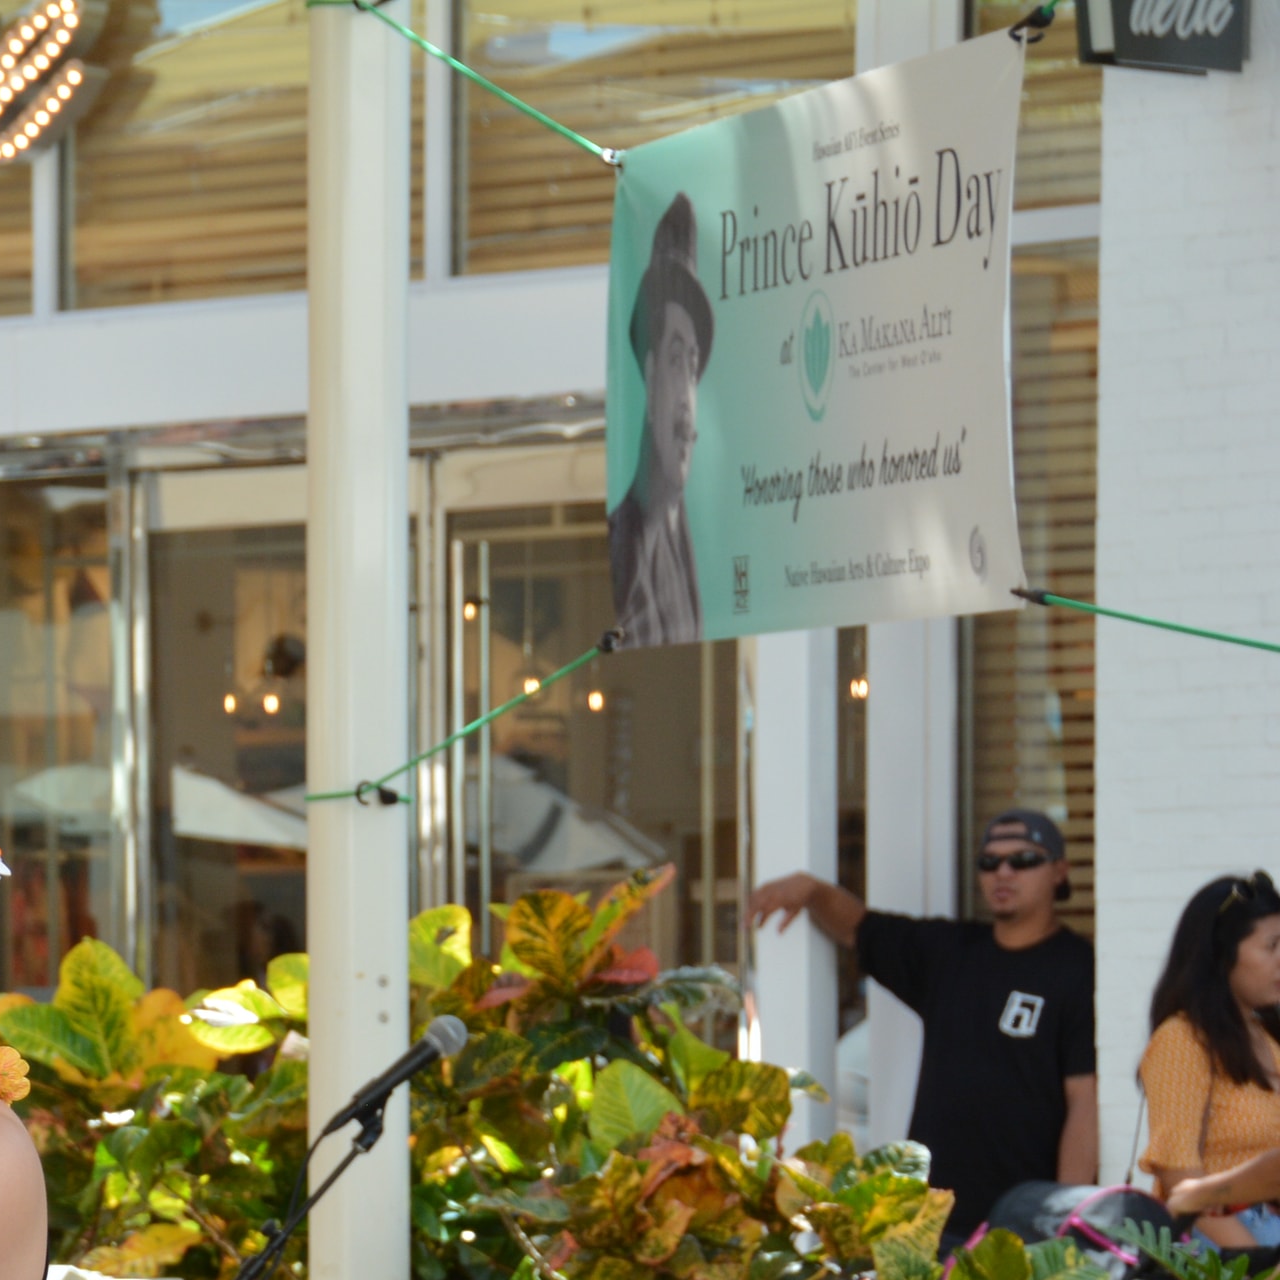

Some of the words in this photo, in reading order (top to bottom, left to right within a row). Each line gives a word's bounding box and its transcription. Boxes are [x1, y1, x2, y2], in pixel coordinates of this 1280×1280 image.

[719, 203, 813, 300] Prince
[824, 165, 921, 274] Kūhiō
[932, 147, 1003, 270] Day
[807, 450, 843, 497] those
[847, 440, 875, 490] who
[878, 431, 940, 486] honored
